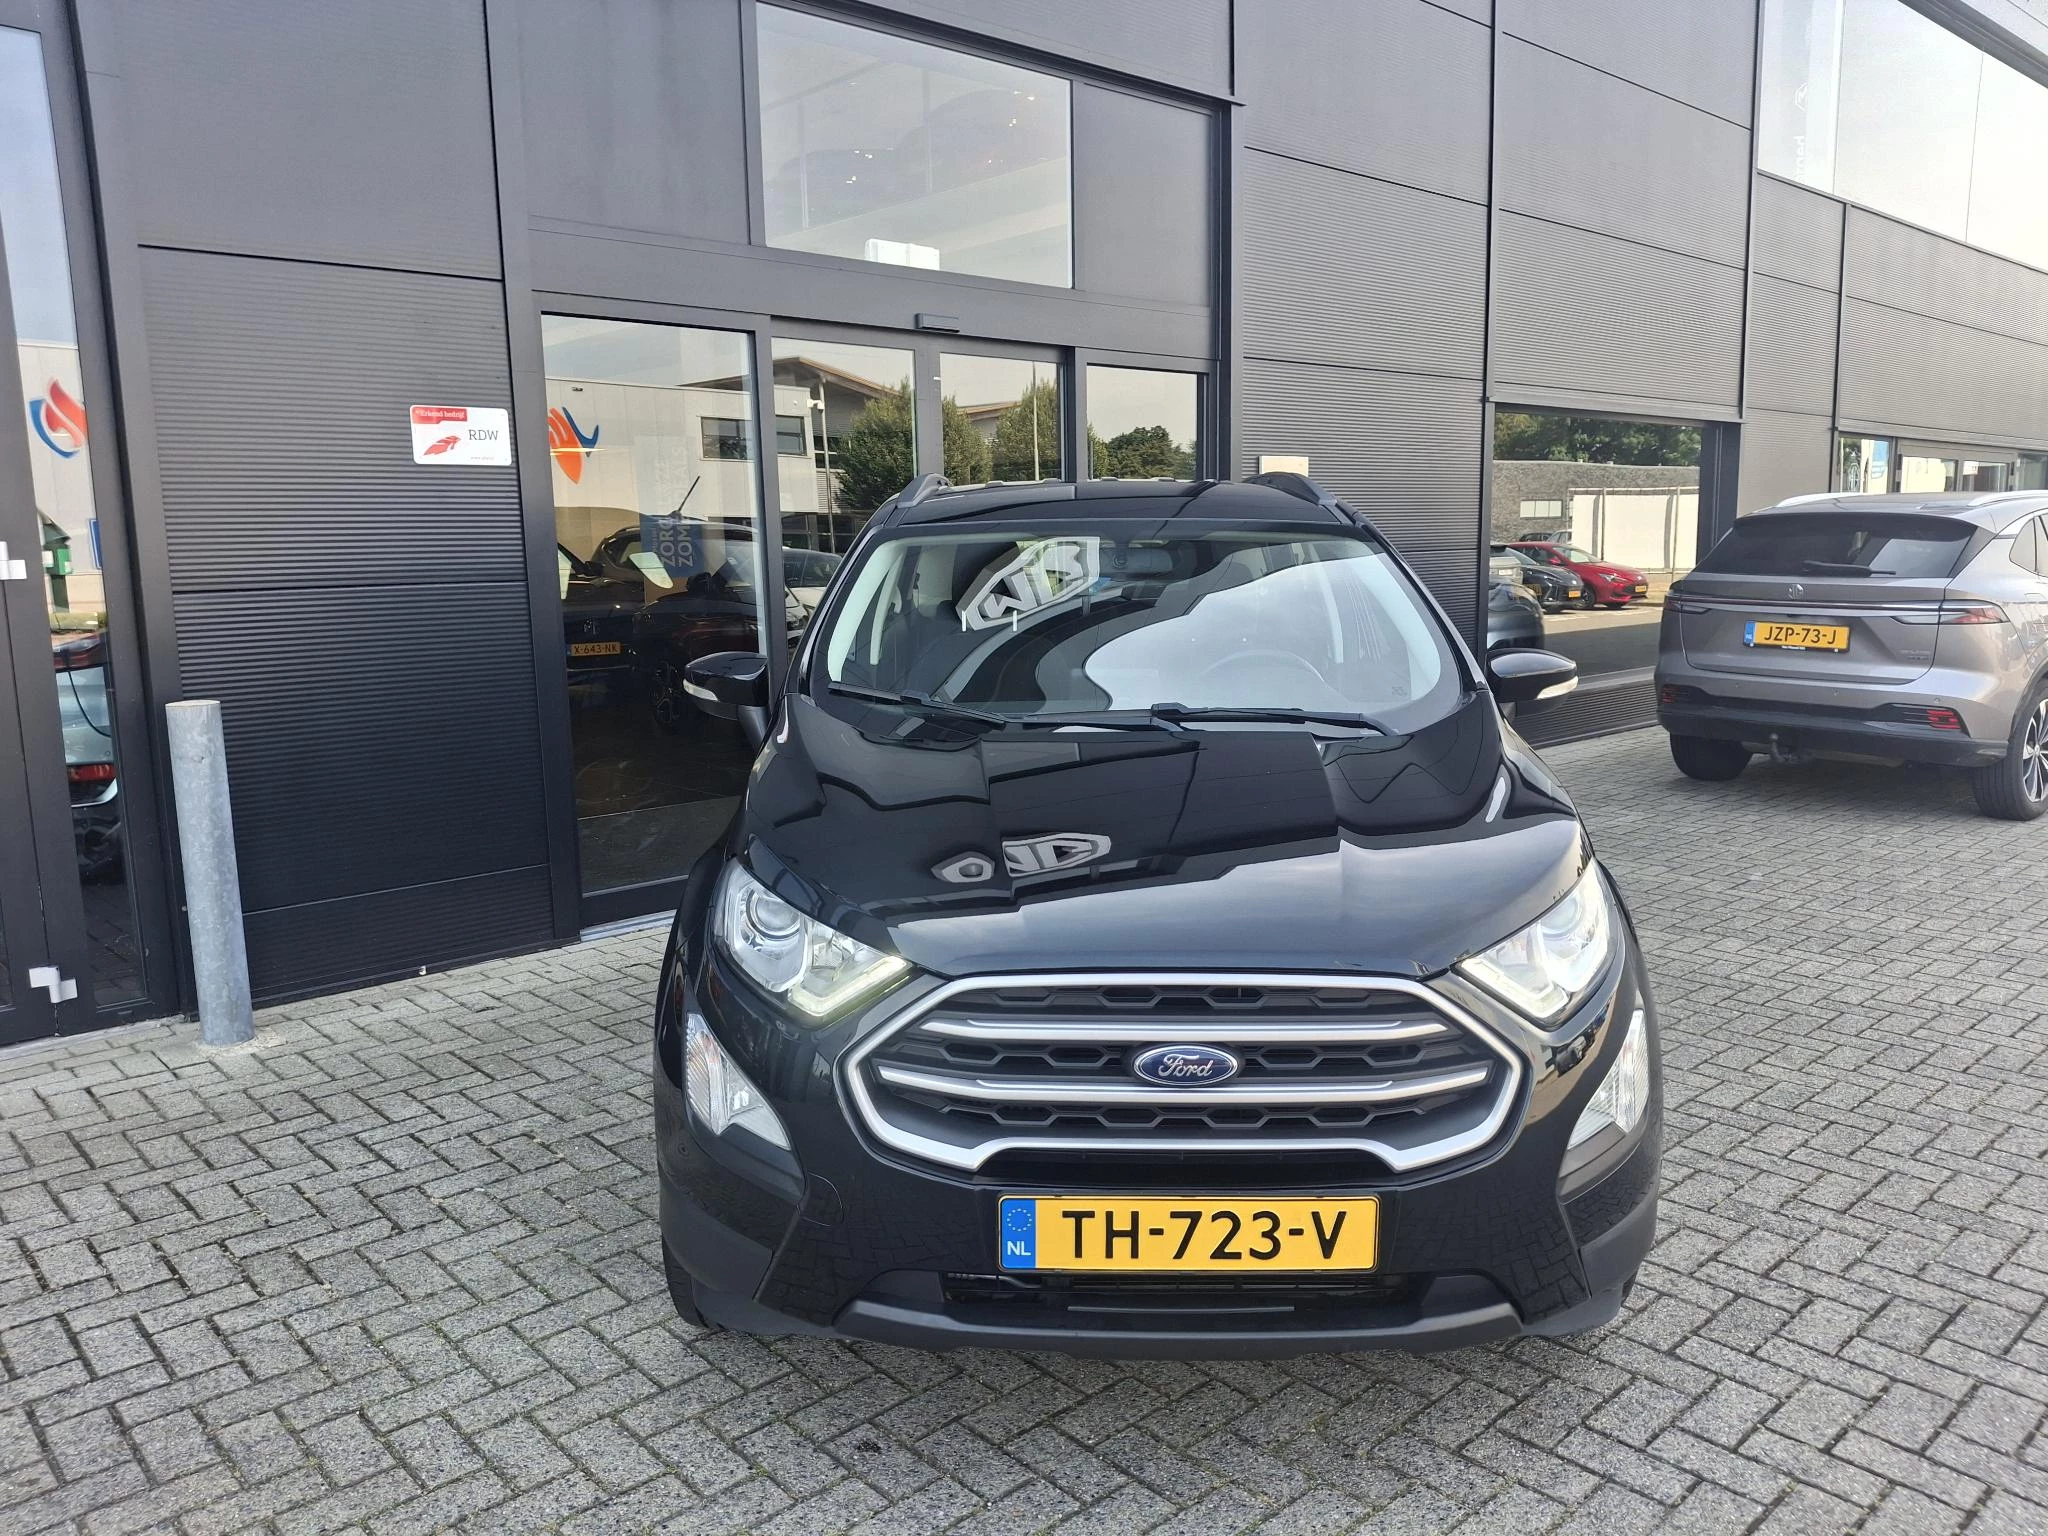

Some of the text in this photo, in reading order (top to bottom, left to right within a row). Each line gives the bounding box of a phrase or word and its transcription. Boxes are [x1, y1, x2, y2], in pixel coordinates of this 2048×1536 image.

[468, 429, 499, 441] RDW
[1764, 625, 1838, 645] JZP-73-J
[573, 643, 618, 655] X-643-NK
[1158, 1053, 1214, 1077] Ford
[1006, 1209, 1347, 1261] NL TH-723-V
